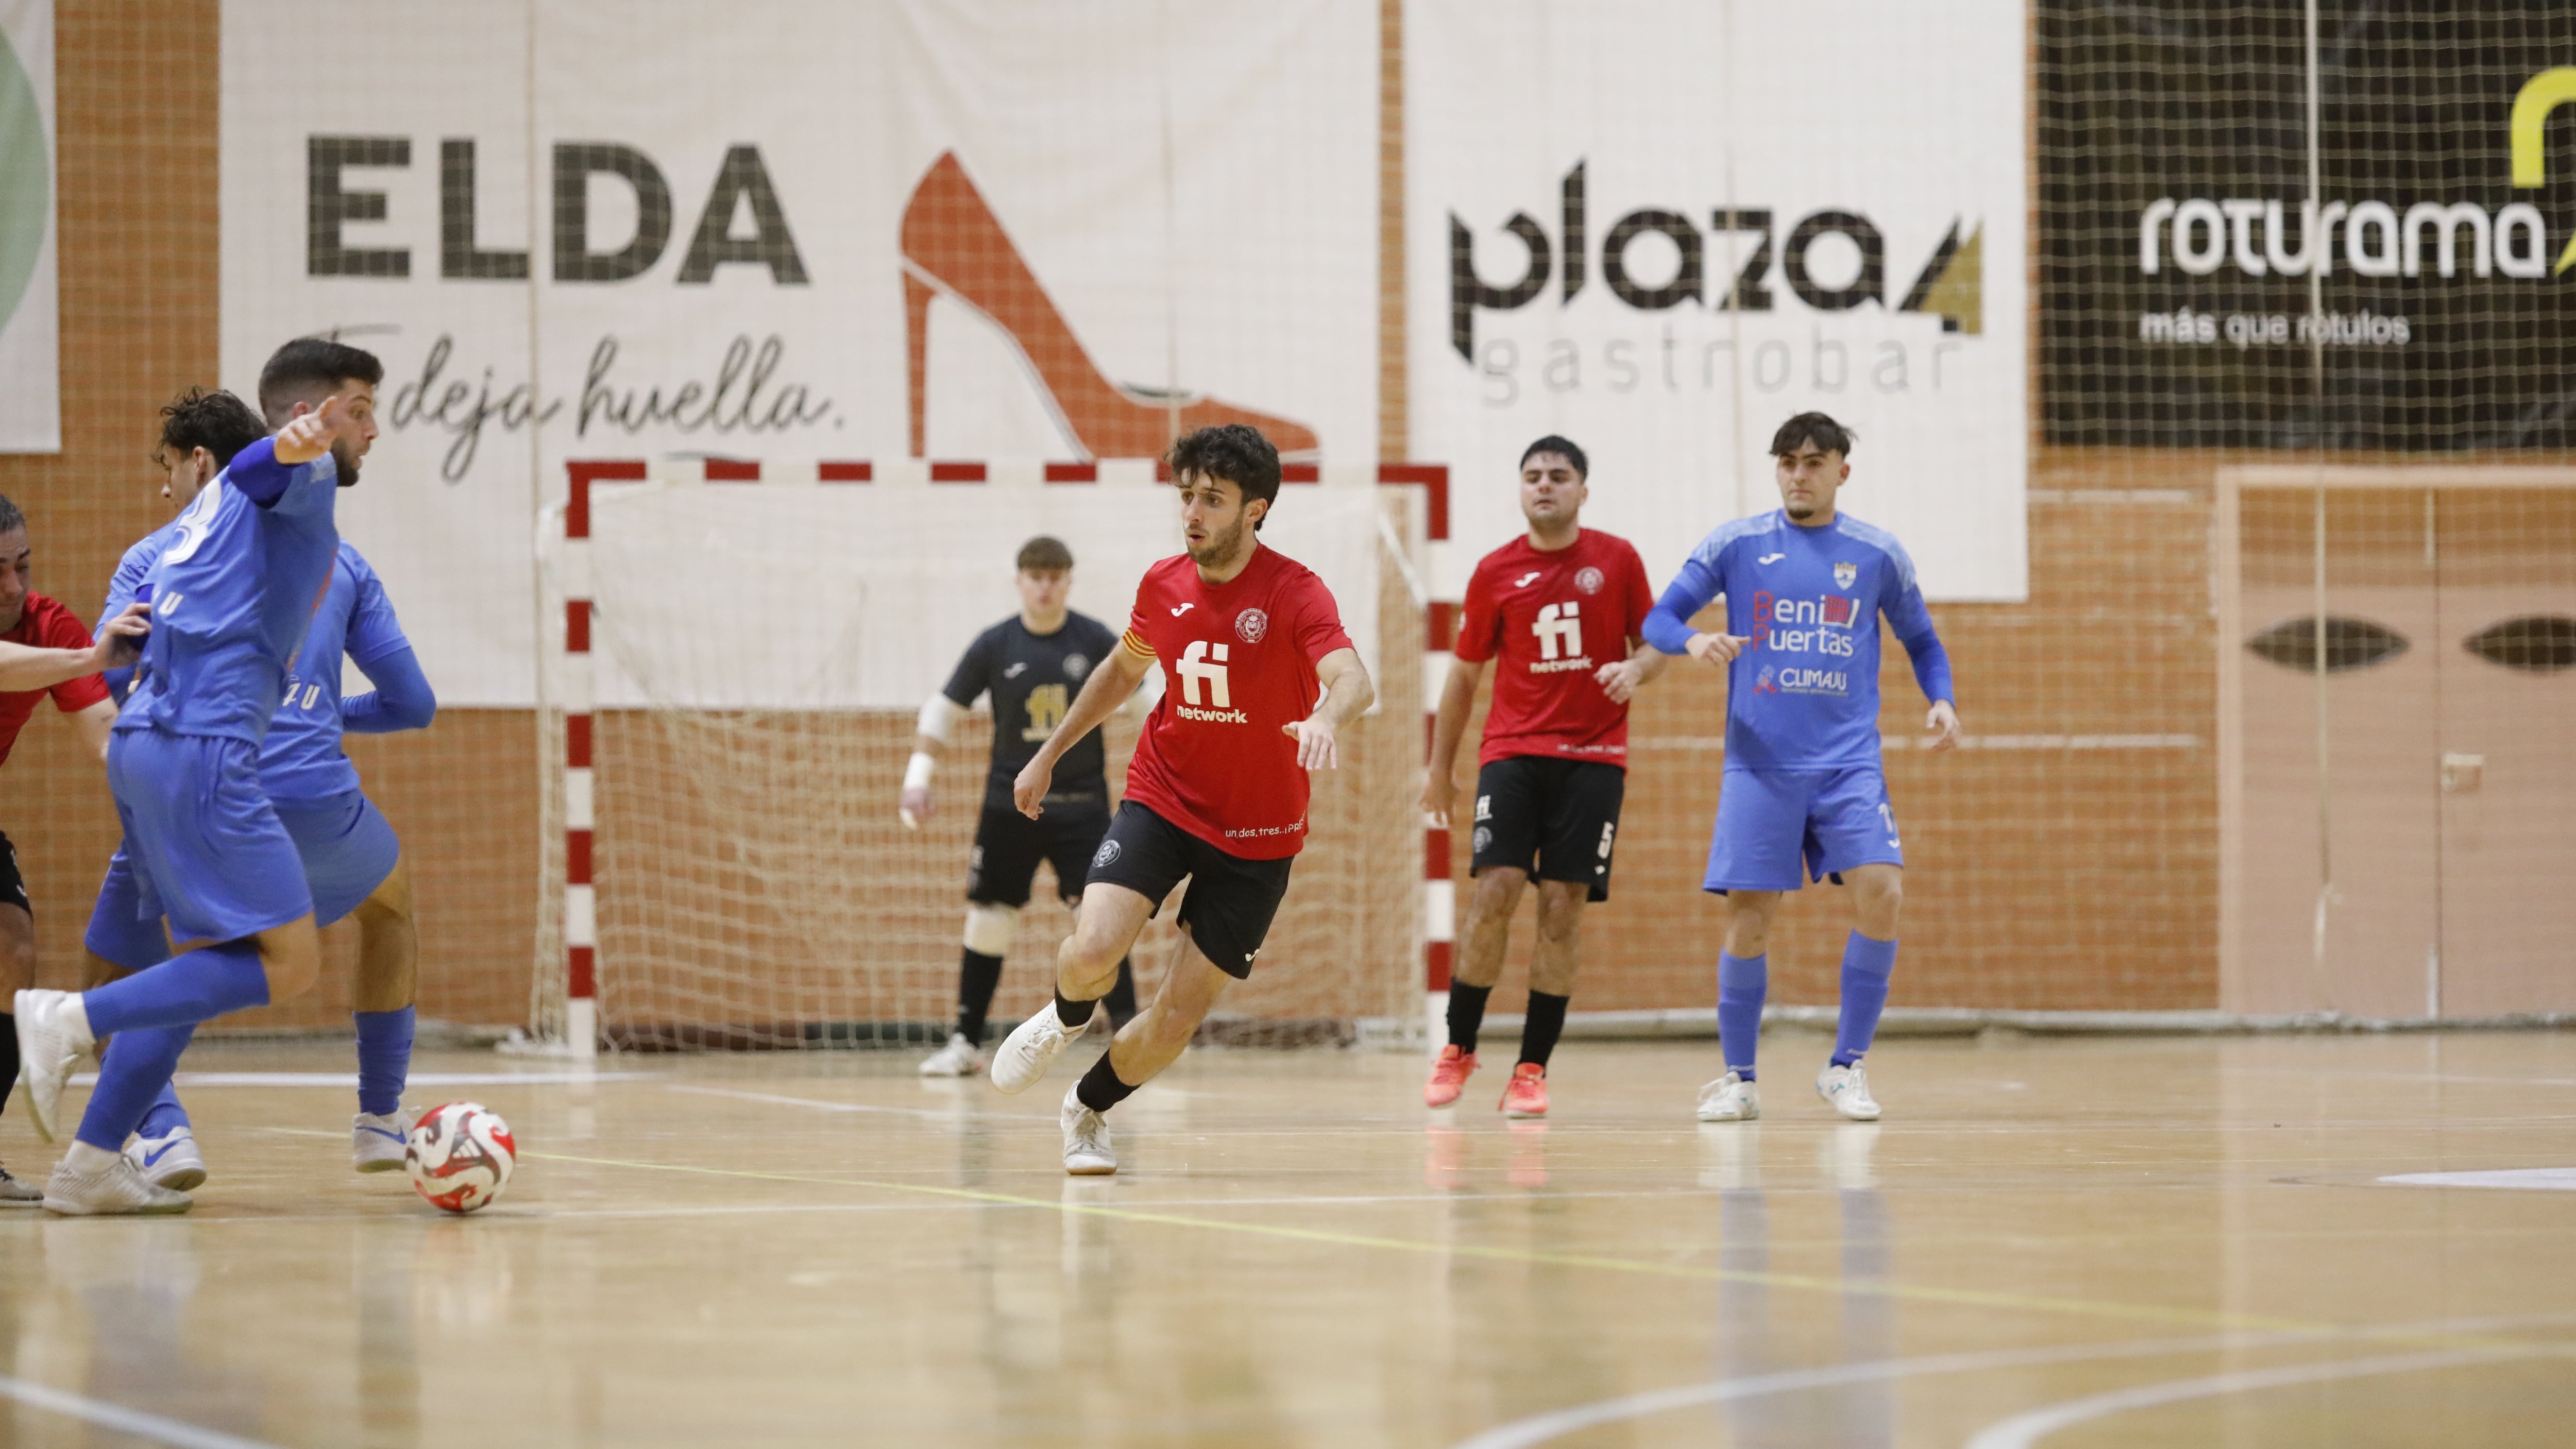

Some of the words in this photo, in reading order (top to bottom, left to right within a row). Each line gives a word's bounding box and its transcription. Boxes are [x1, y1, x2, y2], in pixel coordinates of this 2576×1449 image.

[307, 135, 811, 285] ELDA
[2139, 199, 2547, 278] roturama
[2140, 305, 2216, 342] más
[2225, 312, 2289, 351] que
[1482, 323, 1964, 410] gastrobar
[391, 335, 564, 484] deja
[1531, 601, 1582, 660] fi
[1753, 623, 1854, 657] Puertas
[1176, 640, 1230, 707] fi
[1177, 705, 1248, 723] network
[1597, 821, 1614, 859] 5
